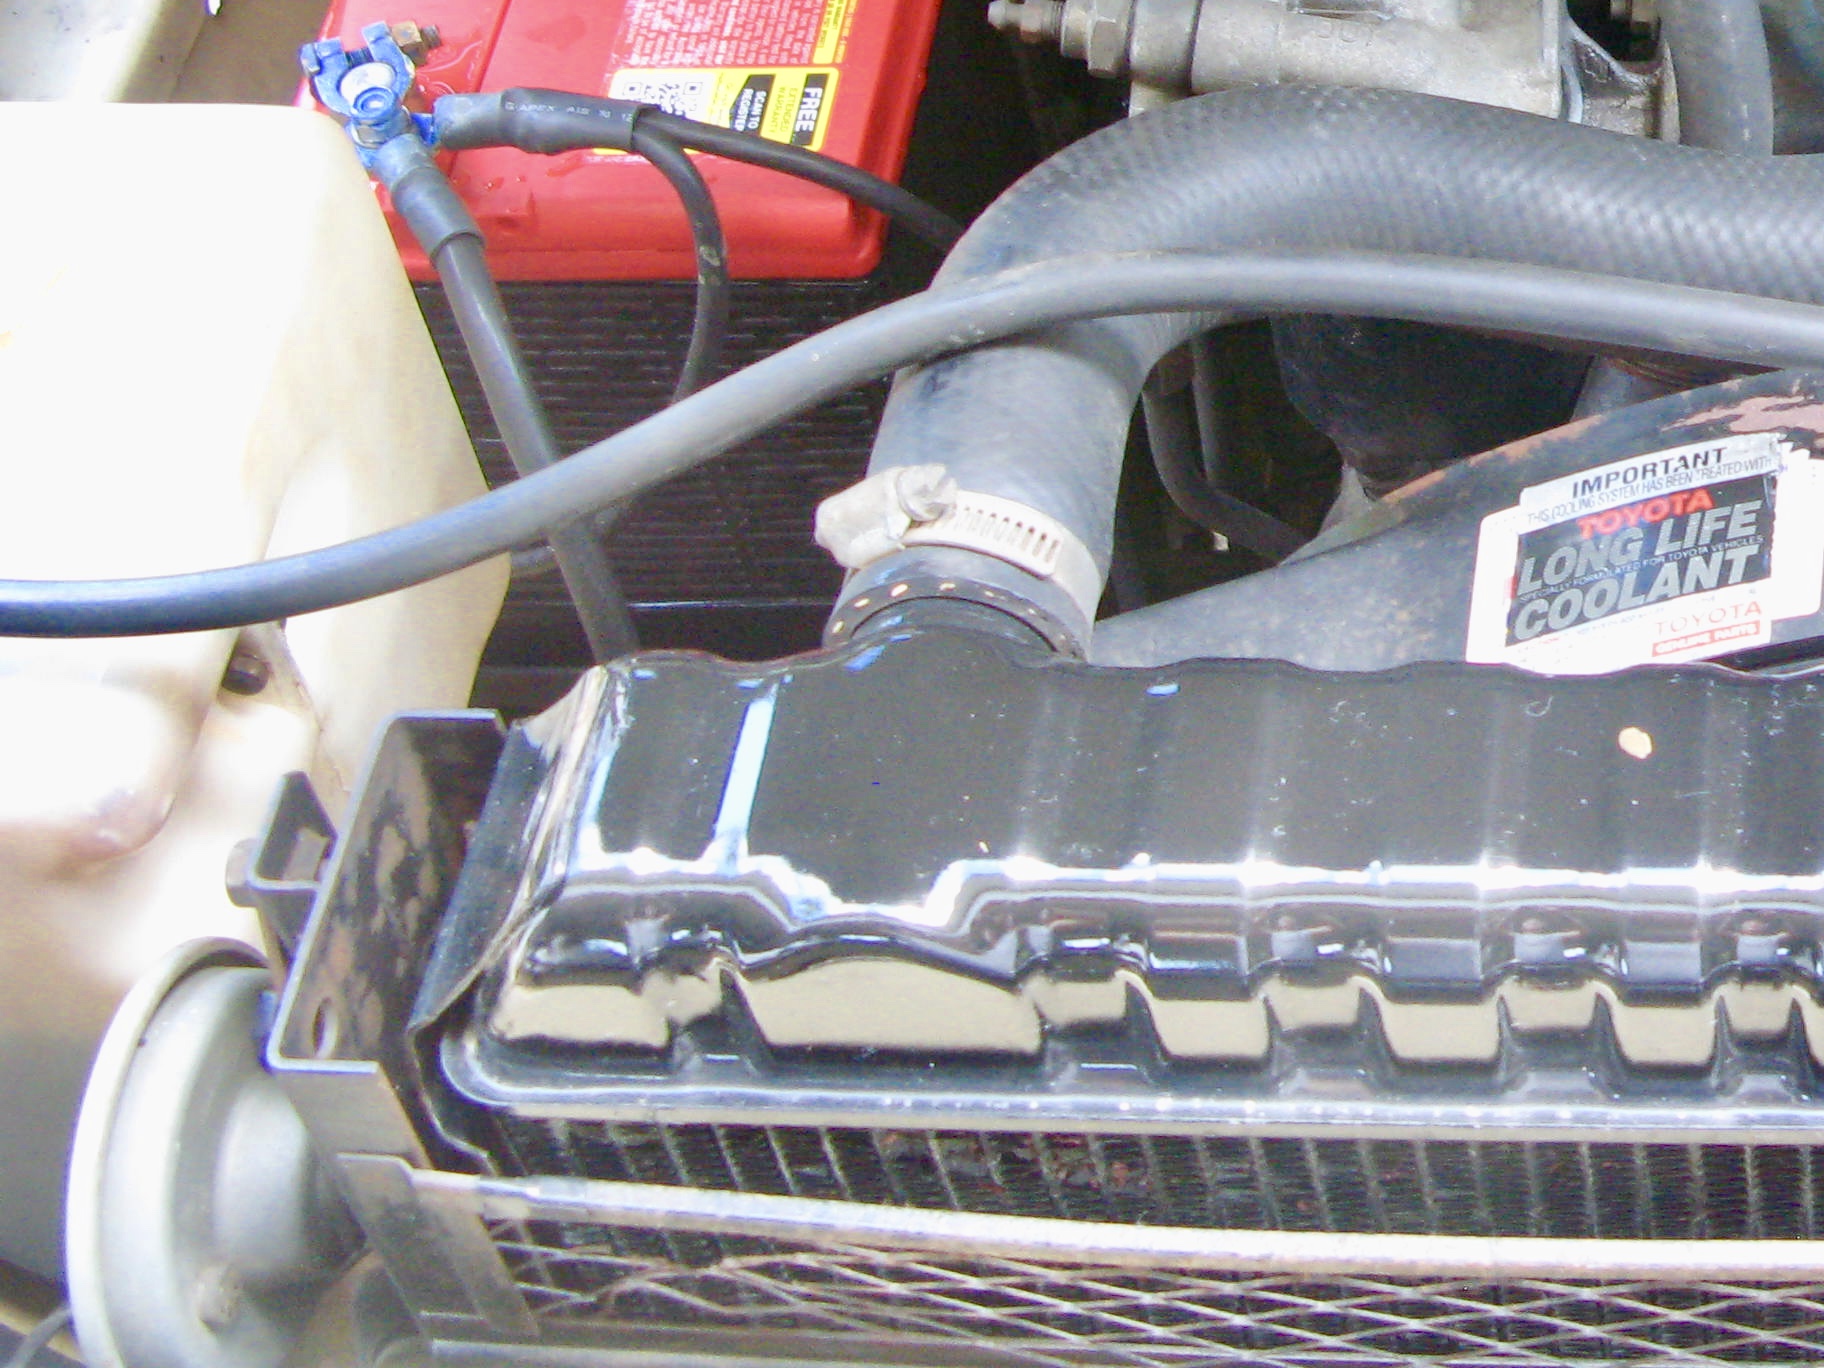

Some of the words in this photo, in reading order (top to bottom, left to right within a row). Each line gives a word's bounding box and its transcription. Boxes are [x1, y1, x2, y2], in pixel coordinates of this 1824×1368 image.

[747, 117, 760, 129] TO
[751, 90, 767, 115] SCAN
[768, 87, 787, 133] WARRANTY
[780, 88, 798, 132] EXTENDED
[795, 87, 824, 132] FREE
[1572, 446, 1728, 499] IMPORTANT
[1599, 483, 1640, 507] SYSTEM
[1642, 476, 1664, 494] HAS
[1666, 470, 1693, 490] BEEN
[1744, 454, 1772, 473] WITH
[1577, 488, 1715, 541] TOYOTA
[1517, 526, 1645, 597] LONG
[1655, 498, 1763, 556] LIFE
[1642, 554, 1666, 569] FOR
[1668, 546, 1709, 563] TOYOTA
[1711, 534, 1765, 553] VEHICLES
[1514, 543, 1760, 640] COOLANT
[1656, 601, 1762, 637] TOYOTA
